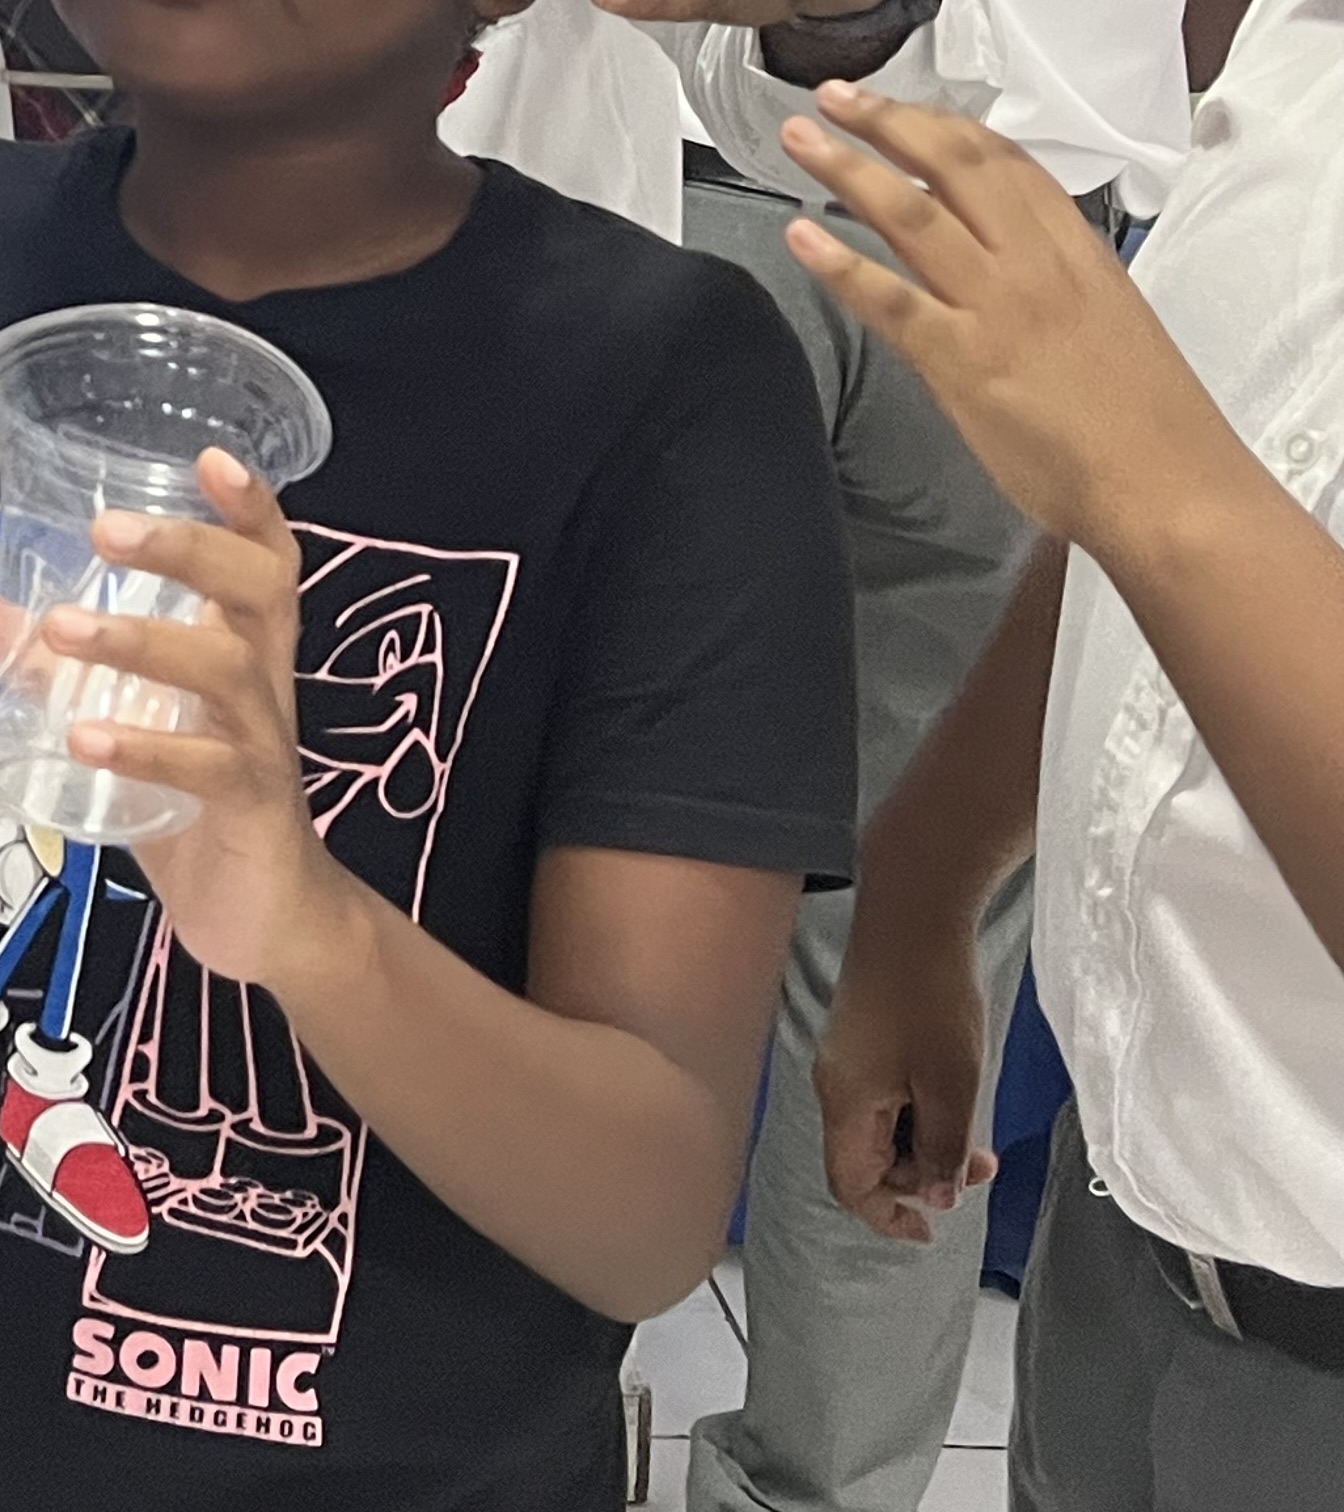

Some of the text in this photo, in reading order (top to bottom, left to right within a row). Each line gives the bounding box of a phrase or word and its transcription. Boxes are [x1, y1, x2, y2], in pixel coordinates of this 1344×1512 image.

[72, 1318, 321, 1412] SONIC
[73, 1378, 317, 1439] THE HEDGEHOG
